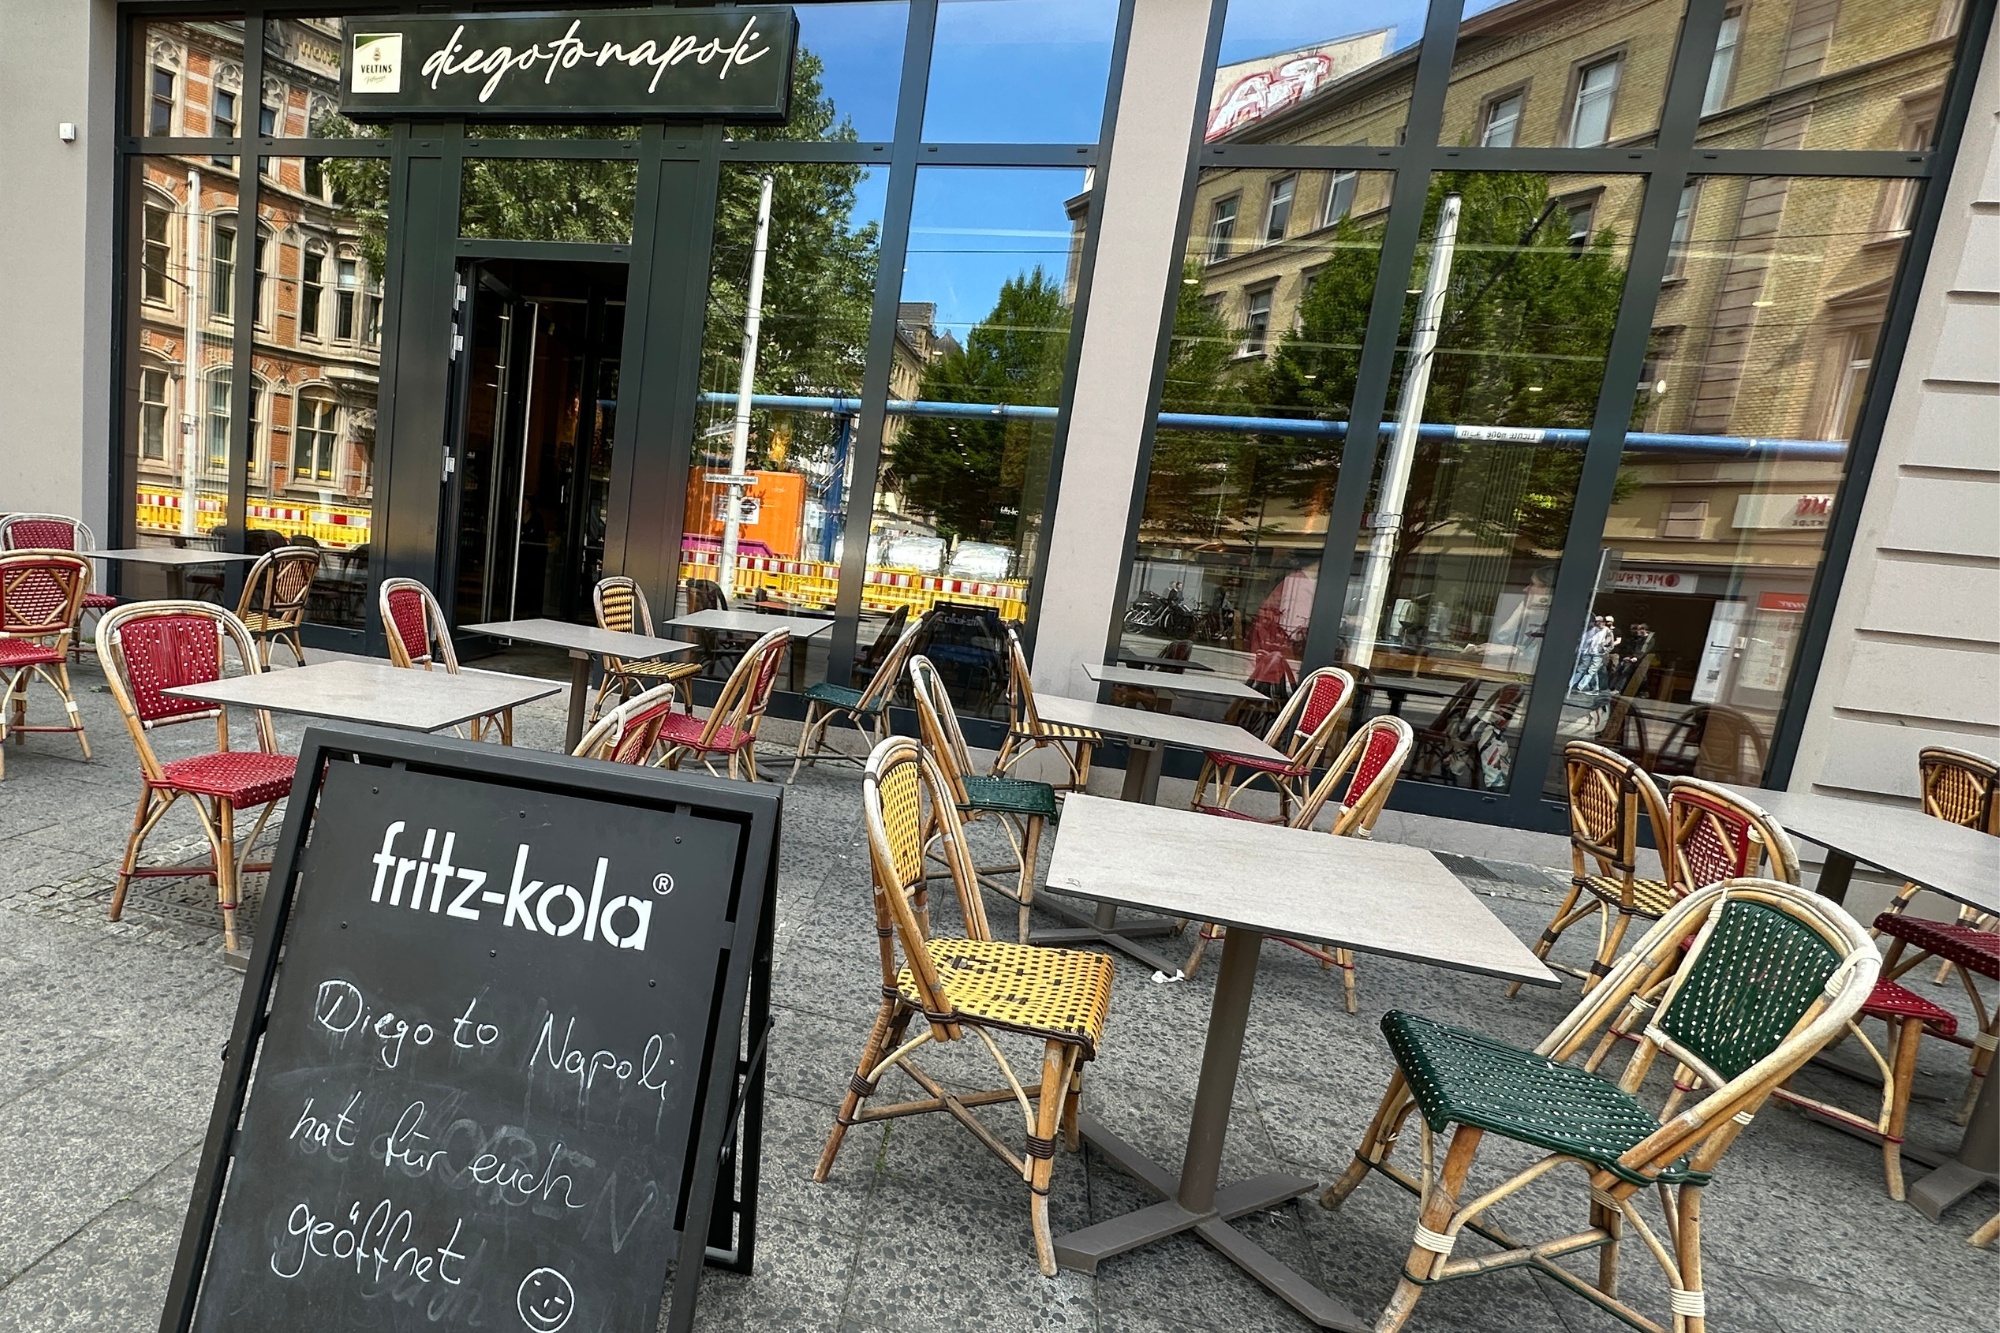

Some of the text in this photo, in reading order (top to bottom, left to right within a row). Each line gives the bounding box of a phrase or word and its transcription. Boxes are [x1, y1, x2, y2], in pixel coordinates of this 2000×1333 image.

[361, 64, 392, 74] VELTINS
[316, 979, 676, 1100] Diego to Napoli
[290, 1090, 364, 1147] hat
[384, 1101, 448, 1171] für
[468, 1143, 588, 1210] euch
[270, 1199, 467, 1285] geöffnet
